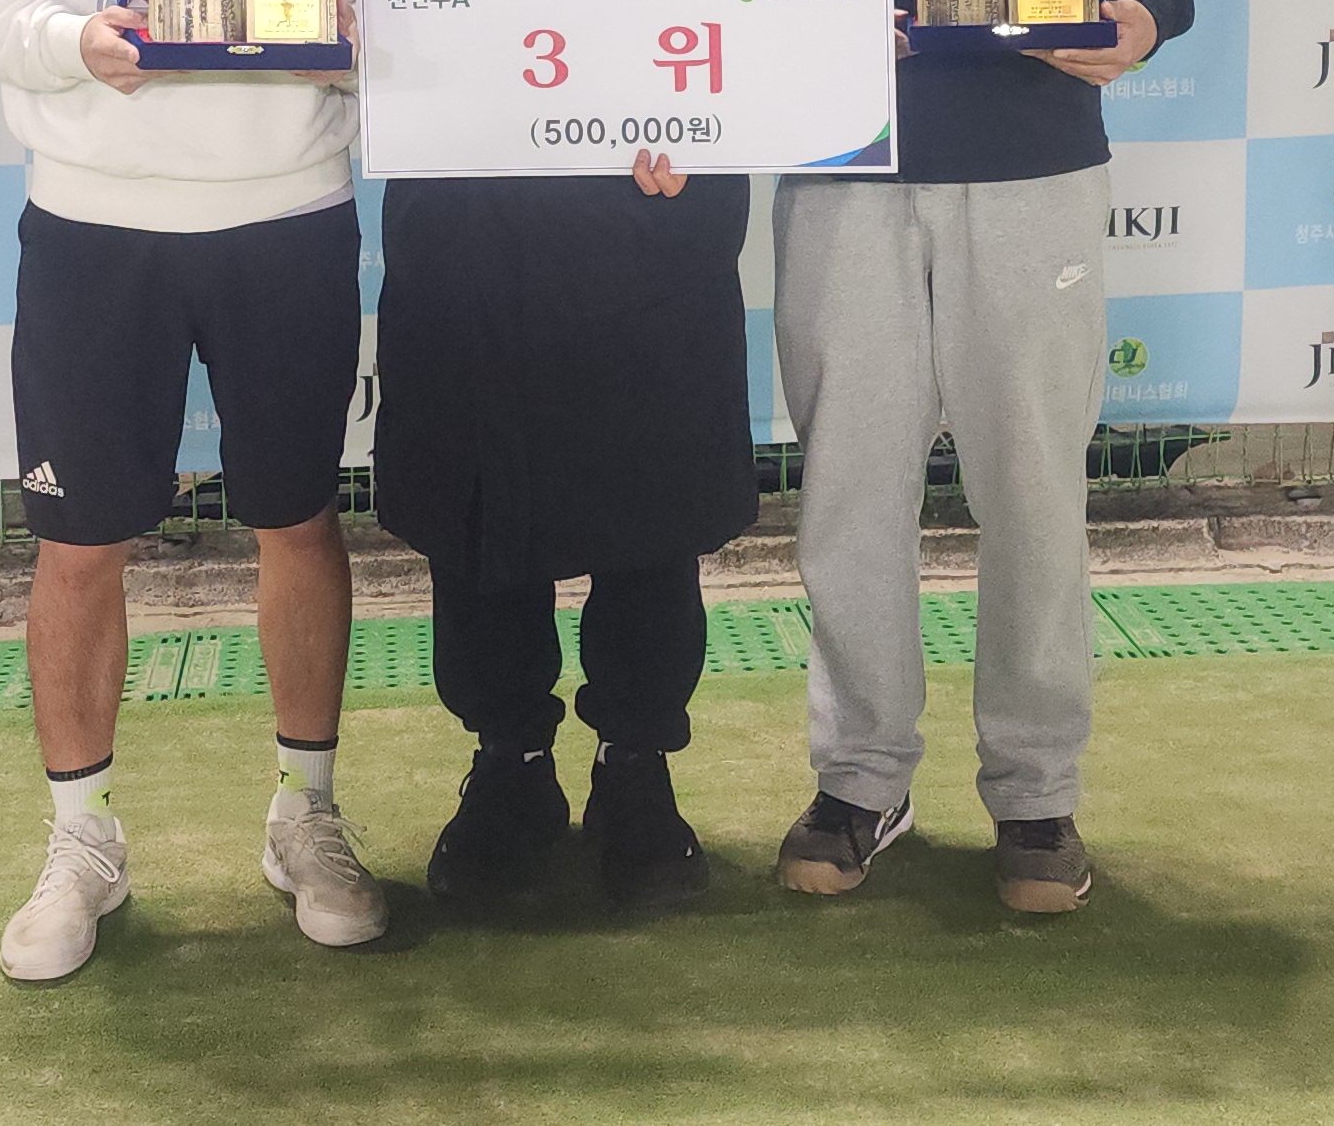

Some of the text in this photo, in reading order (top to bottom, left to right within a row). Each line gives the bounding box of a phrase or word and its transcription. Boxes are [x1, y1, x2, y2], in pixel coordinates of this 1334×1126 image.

[522, 22, 724, 94] 3 위
[1102, 79, 1196, 101] 시테니스협회
[530, 113, 723, 150] (500,000원)
[1105, 205, 1181, 241] IKJI
[1104, 382, 1189, 405] 테니스협회
[22, 478, 65, 498] adidas
